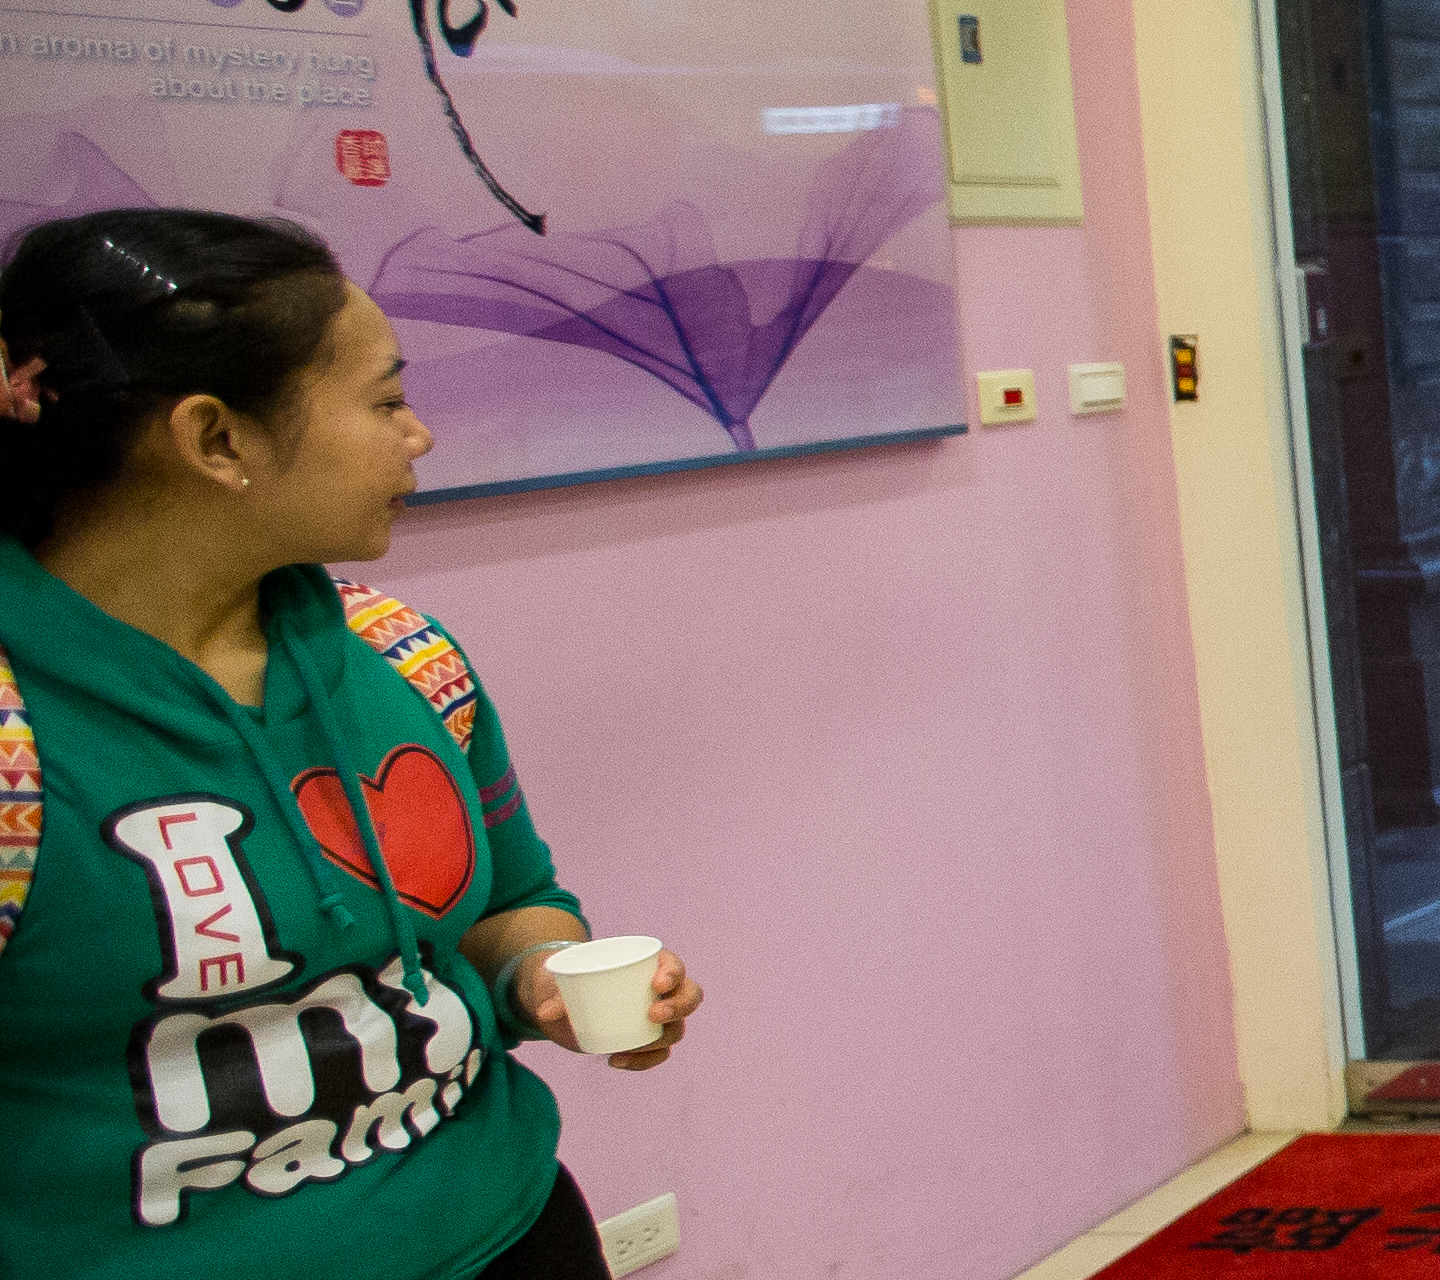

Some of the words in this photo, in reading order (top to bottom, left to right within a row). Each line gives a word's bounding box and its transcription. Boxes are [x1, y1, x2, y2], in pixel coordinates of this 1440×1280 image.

[30, 37, 138, 64] aroma
[143, 38, 178, 62] of
[185, 42, 302, 74] mystery
[147, 74, 239, 102] about
[241, 78, 290, 104] the
[299, 84, 375, 112] place
[156, 810, 246, 993] LOVE
[146, 954, 473, 1134] my
